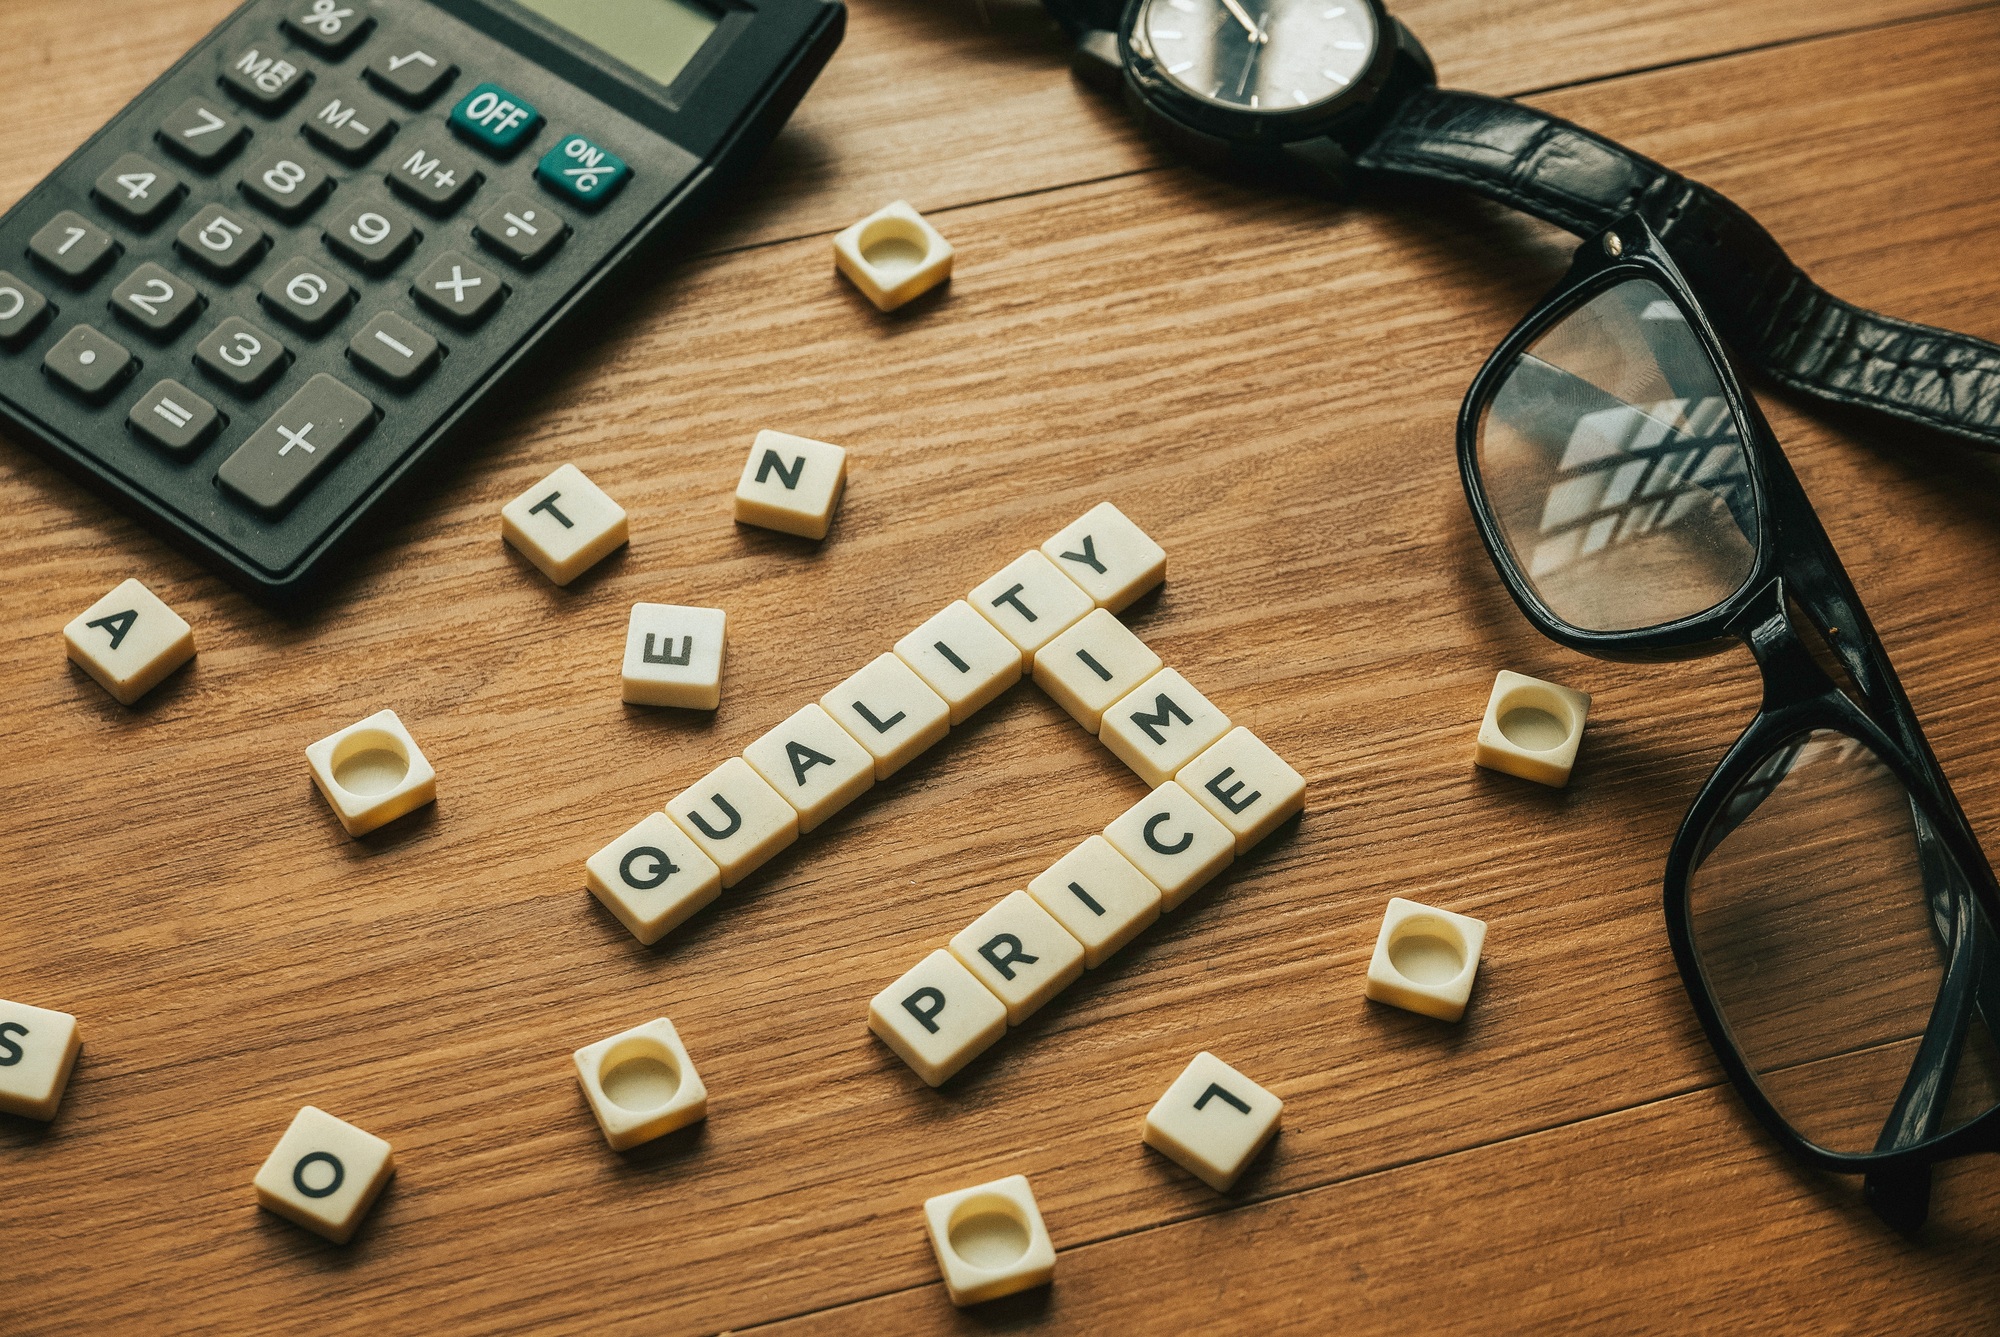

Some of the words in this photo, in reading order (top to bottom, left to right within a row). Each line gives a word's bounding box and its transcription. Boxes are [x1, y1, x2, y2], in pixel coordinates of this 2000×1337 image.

[184, 108, 225, 137] 7
[466, 92, 528, 134] OFF
[117, 172, 156, 199] 4
[263, 161, 305, 193] 8
[403, 150, 456, 188] M+
[58, 227, 86, 255] 1
[199, 216, 243, 251] 5
[350, 213, 390, 244] 9
[129, 279, 173, 315] 2
[286, 273, 327, 305] 6
[219, 333, 261, 366] 3
[528, 491, 574, 529] T
[87, 608, 138, 650] A
[643, 633, 692, 666] E
[619, 535, 1107, 890] QUALITY
[900, 767, 1261, 1035] PRICE
[0, 1022, 29, 1066] S
[293, 1152, 344, 1198] O
